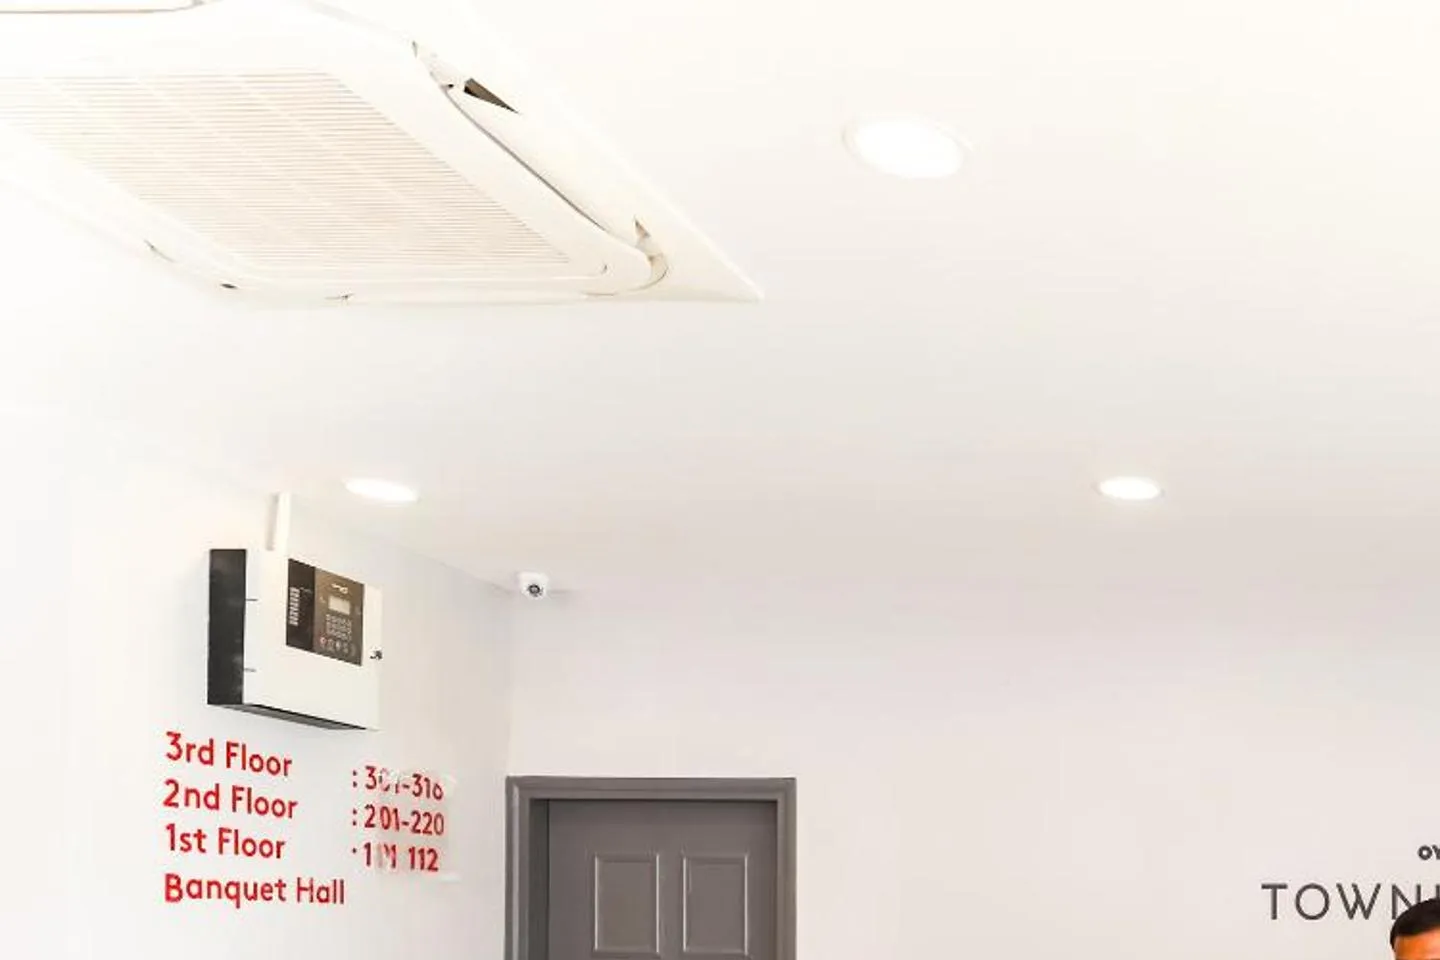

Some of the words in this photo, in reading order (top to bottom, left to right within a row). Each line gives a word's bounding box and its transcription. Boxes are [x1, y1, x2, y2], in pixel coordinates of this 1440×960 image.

[165, 731, 214, 766] 3rd
[225, 741, 292, 776] Floor
[163, 779, 220, 811] 2nd
[231, 784, 298, 819] Floor
[364, 804, 445, 836] 201-220
[166, 823, 207, 854] 1st
[218, 827, 286, 860] Floor
[164, 873, 287, 909] Banquet
[297, 877, 345, 905] Hall
